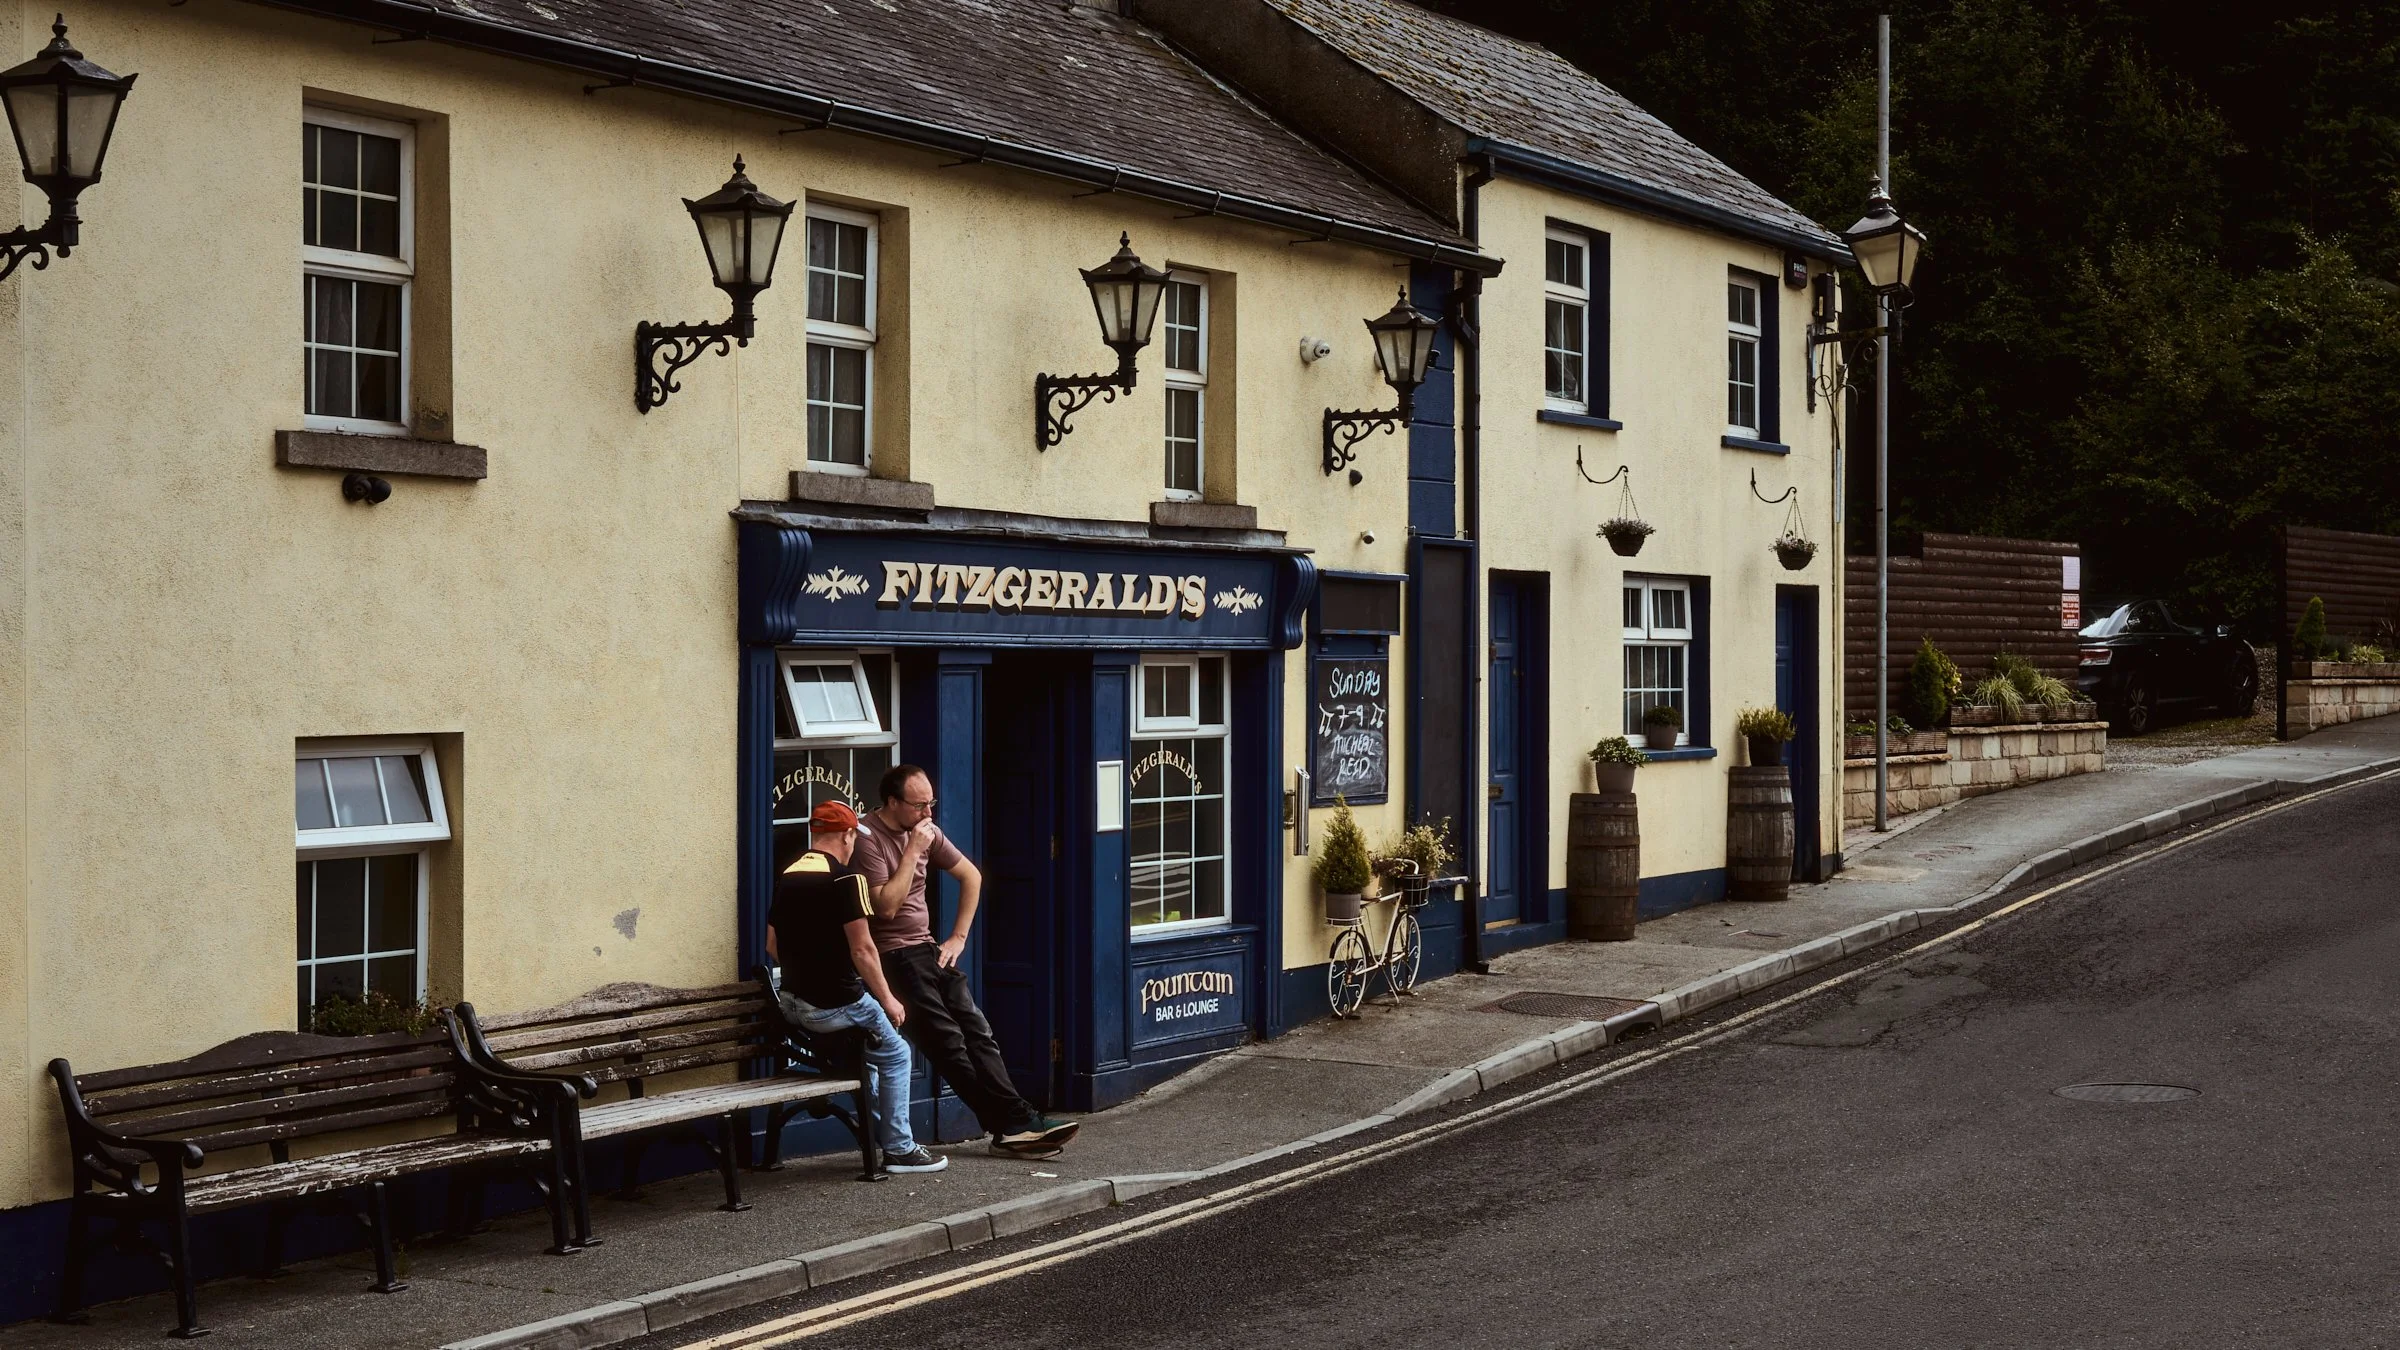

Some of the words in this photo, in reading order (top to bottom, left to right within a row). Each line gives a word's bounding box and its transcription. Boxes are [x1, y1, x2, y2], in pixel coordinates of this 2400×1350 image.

[879, 560, 1206, 617] FITZGERALD'S
[1335, 704, 1364, 729] 7-9
[1130, 750, 1203, 795] ITZGERALD'S
[1155, 1005, 1174, 1022] BAR
[1175, 1005, 1182, 1018] &
[1183, 998, 1219, 1017] LOUNGE
